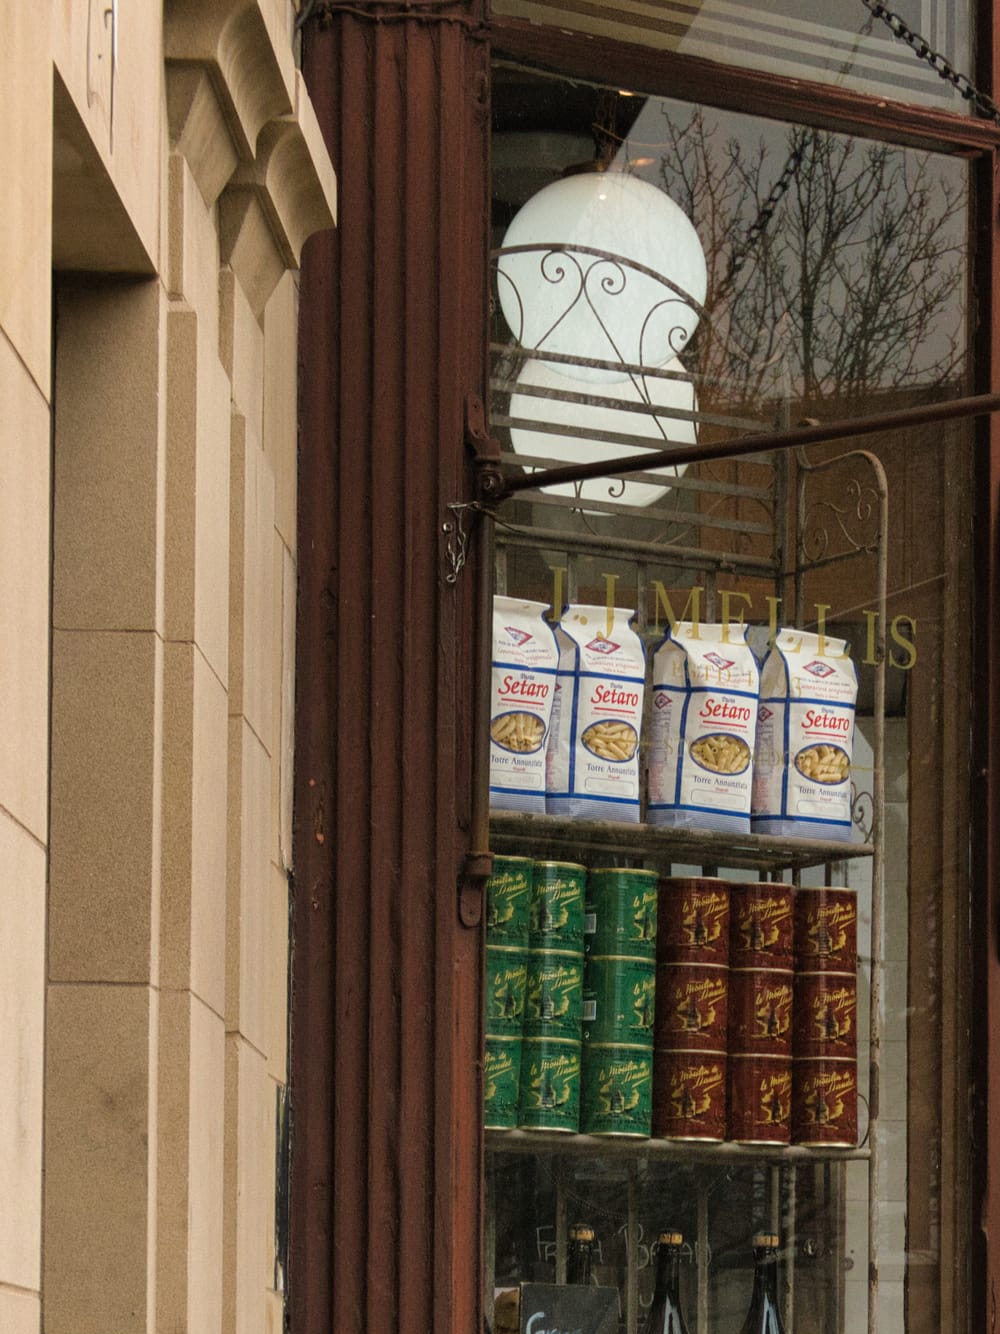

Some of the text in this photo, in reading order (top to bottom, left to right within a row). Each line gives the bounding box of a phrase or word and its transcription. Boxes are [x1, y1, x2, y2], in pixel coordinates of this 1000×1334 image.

[497, 675, 550, 698] Setaro
[590, 684, 639, 707] Setaro
[699, 698, 751, 721] Setaro
[801, 709, 850, 731] Setaro
